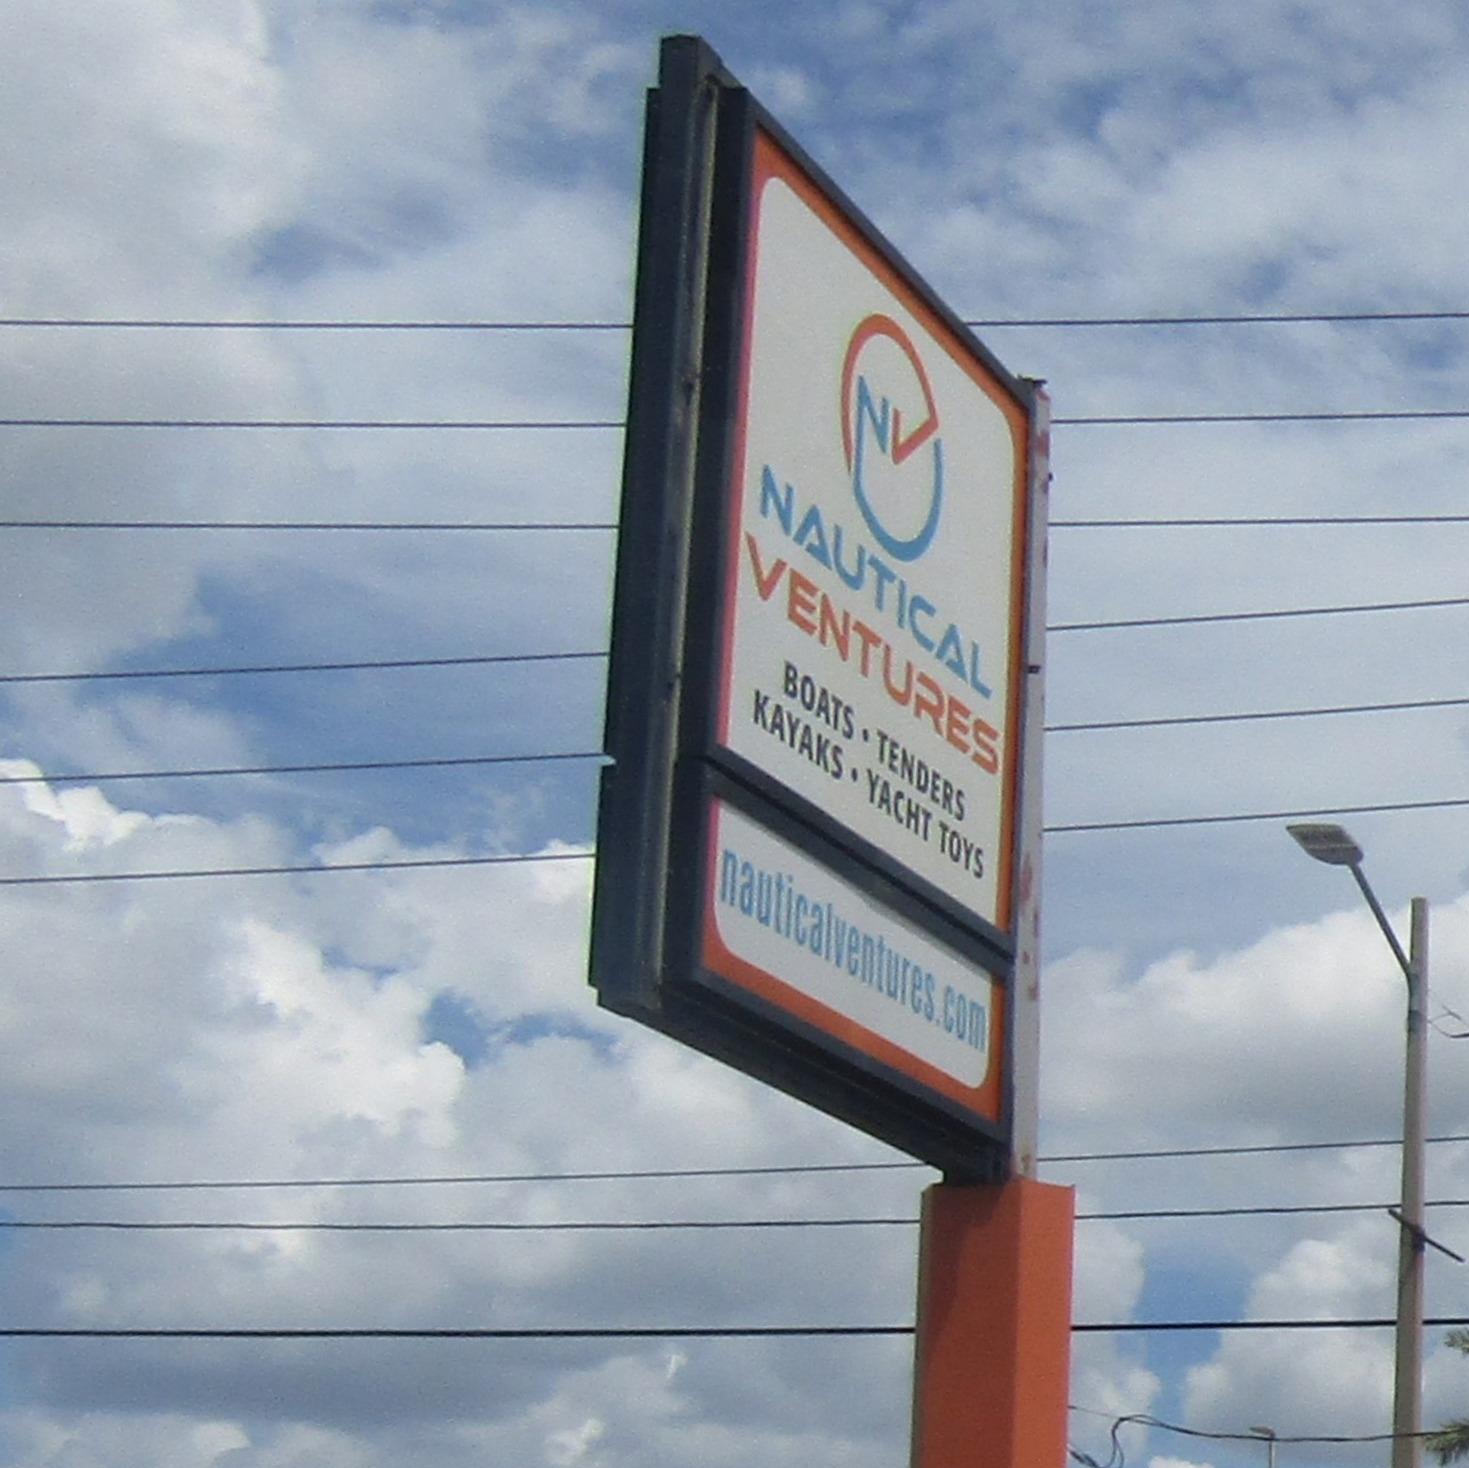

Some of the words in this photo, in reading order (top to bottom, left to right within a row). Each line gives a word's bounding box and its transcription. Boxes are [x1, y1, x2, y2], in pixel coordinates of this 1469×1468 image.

[746, 531, 1000, 776] VENTURES
[760, 463, 992, 699] NAUTICAL
[753, 688, 843, 780] KAYAKS
[866, 768, 933, 842] YACHT
[938, 820, 984, 879] TOYS
[783, 660, 854, 740] BOATS
[877, 728, 965, 822] TENDERS
[720, 848, 988, 1053] nauticalventures.com
